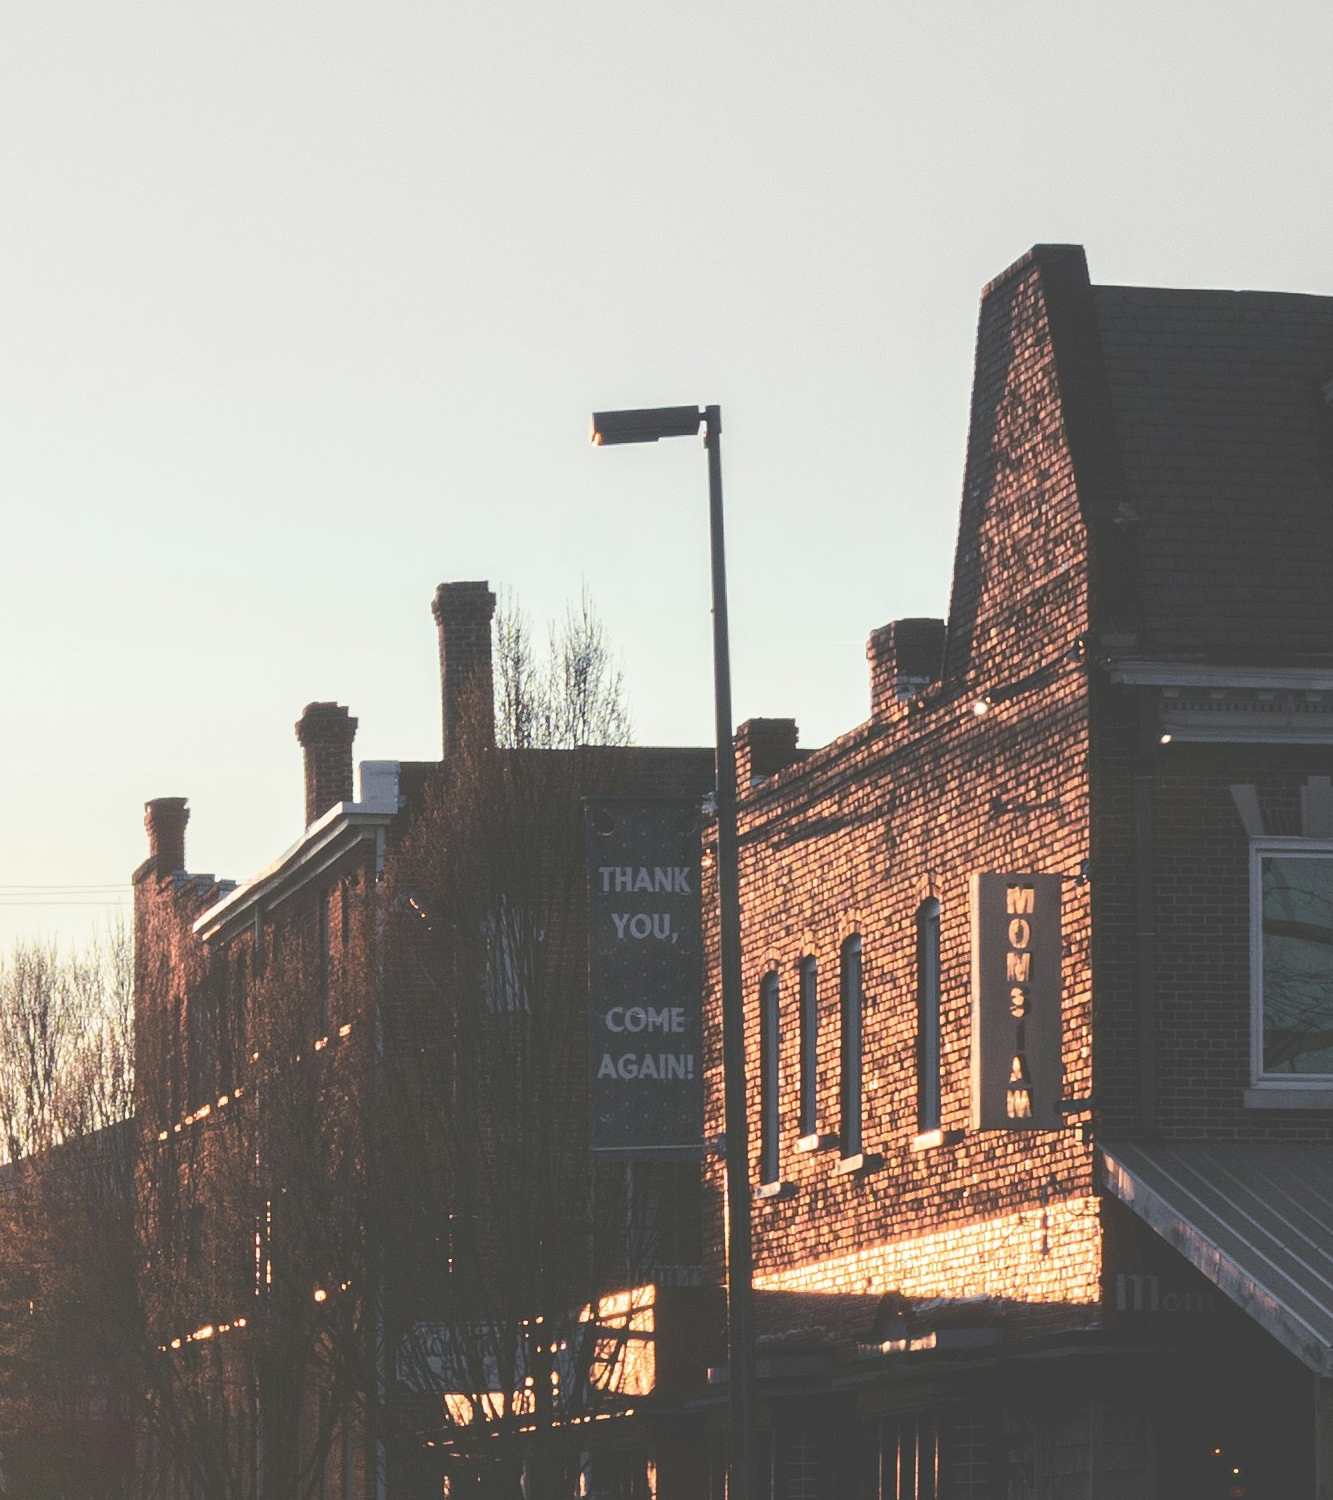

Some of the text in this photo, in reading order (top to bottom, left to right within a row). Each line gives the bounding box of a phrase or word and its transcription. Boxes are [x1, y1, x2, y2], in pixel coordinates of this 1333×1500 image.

[598, 866, 691, 893] THANK
[610, 913, 679, 943] YOU,
[605, 1006, 685, 1033] COME
[597, 1053, 694, 1080] AGAIN!
